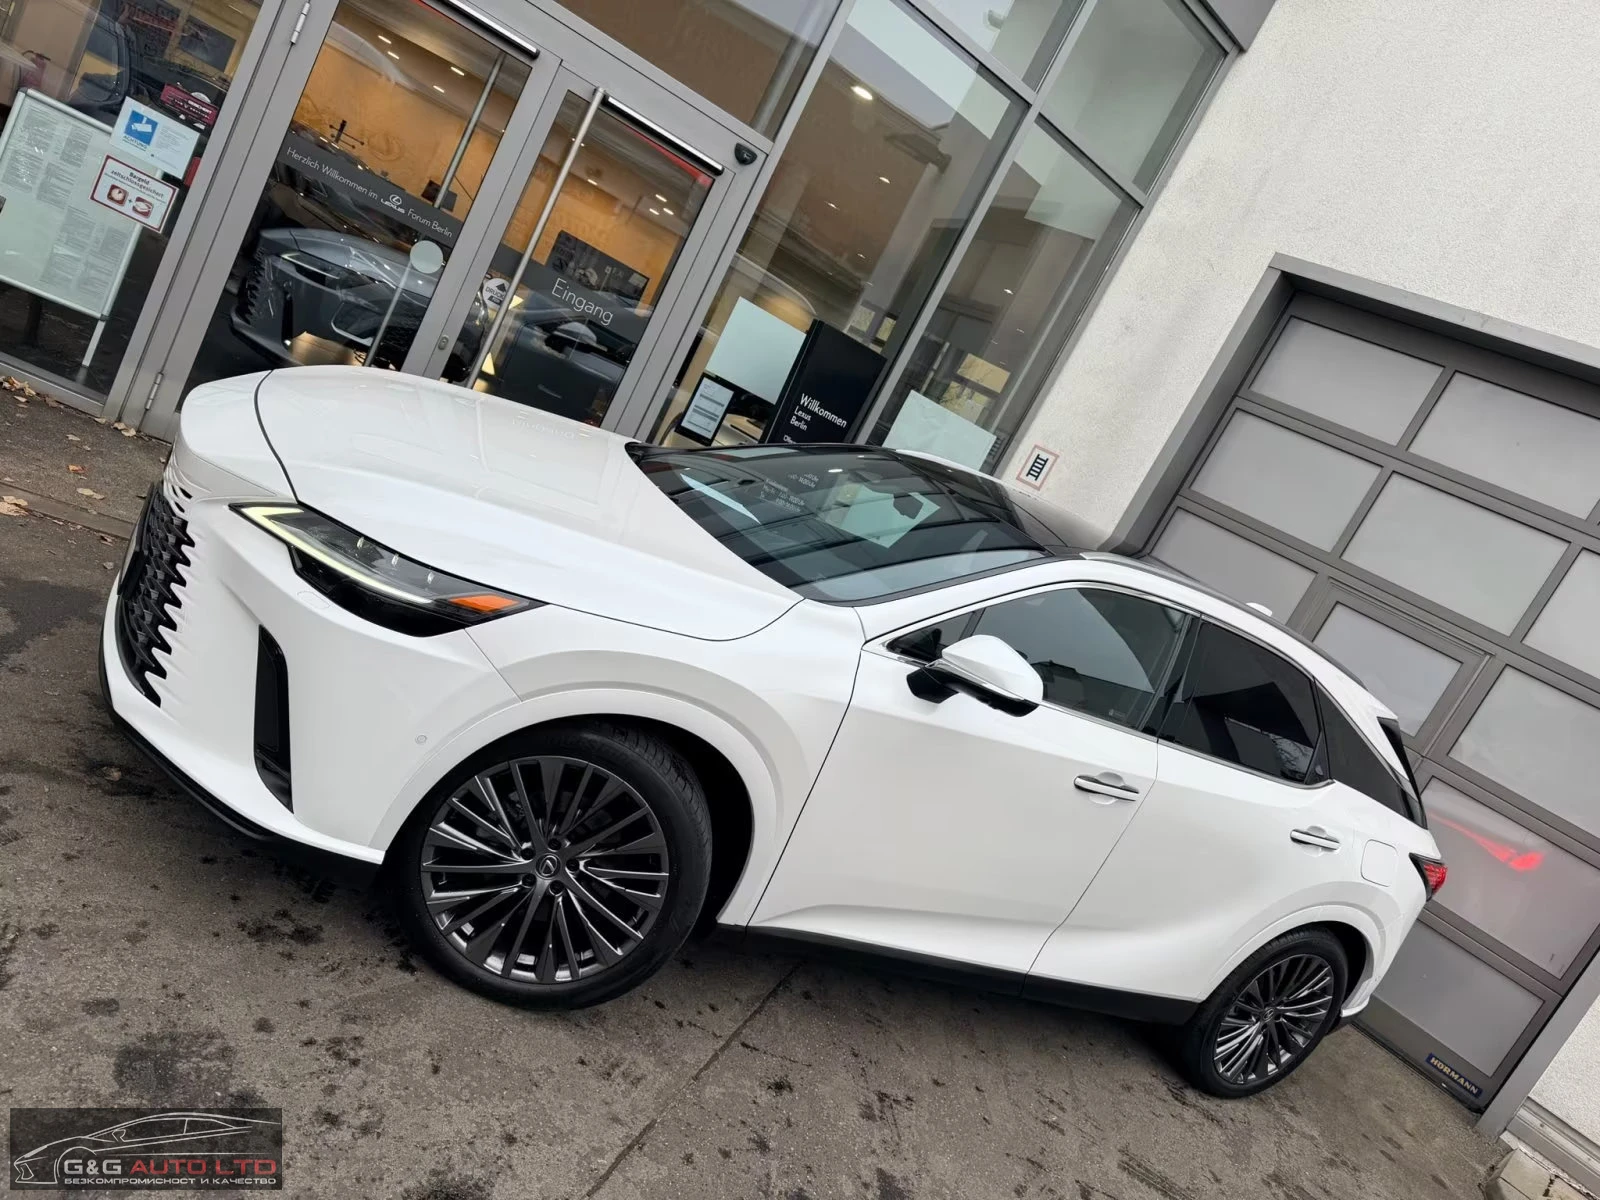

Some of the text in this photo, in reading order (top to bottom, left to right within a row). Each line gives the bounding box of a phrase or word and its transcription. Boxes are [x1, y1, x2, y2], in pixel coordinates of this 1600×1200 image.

[128, 171, 151, 186] Bargeld
[286, 146, 454, 238] Herzlich Willkommen im LEXUS Forum Berlin
[551, 277, 614, 326] Eingang
[790, 415, 808, 431] Berlin
[794, 405, 812, 421] Lexus
[800, 392, 847, 429] Willkommen
